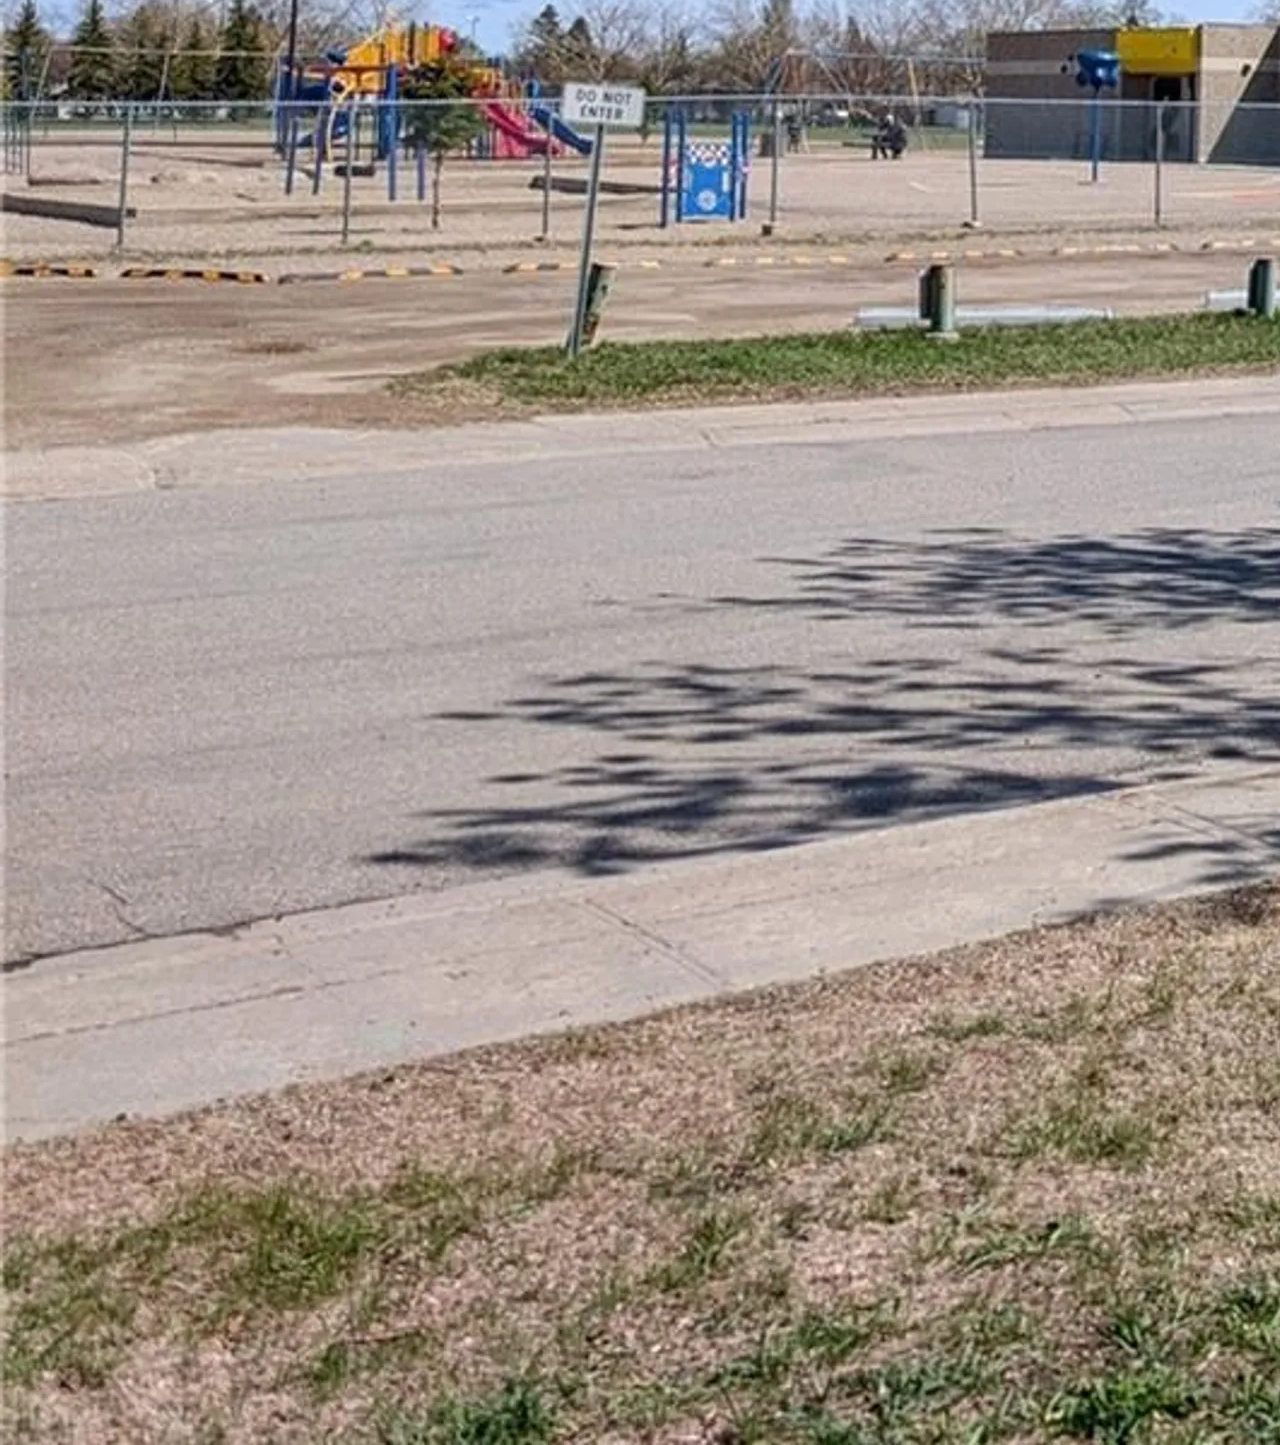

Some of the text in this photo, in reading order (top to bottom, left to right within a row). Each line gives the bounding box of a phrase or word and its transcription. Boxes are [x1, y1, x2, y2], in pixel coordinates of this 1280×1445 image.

[575, 88, 633, 105] DO NOT
[580, 103, 625, 119] ENTER
